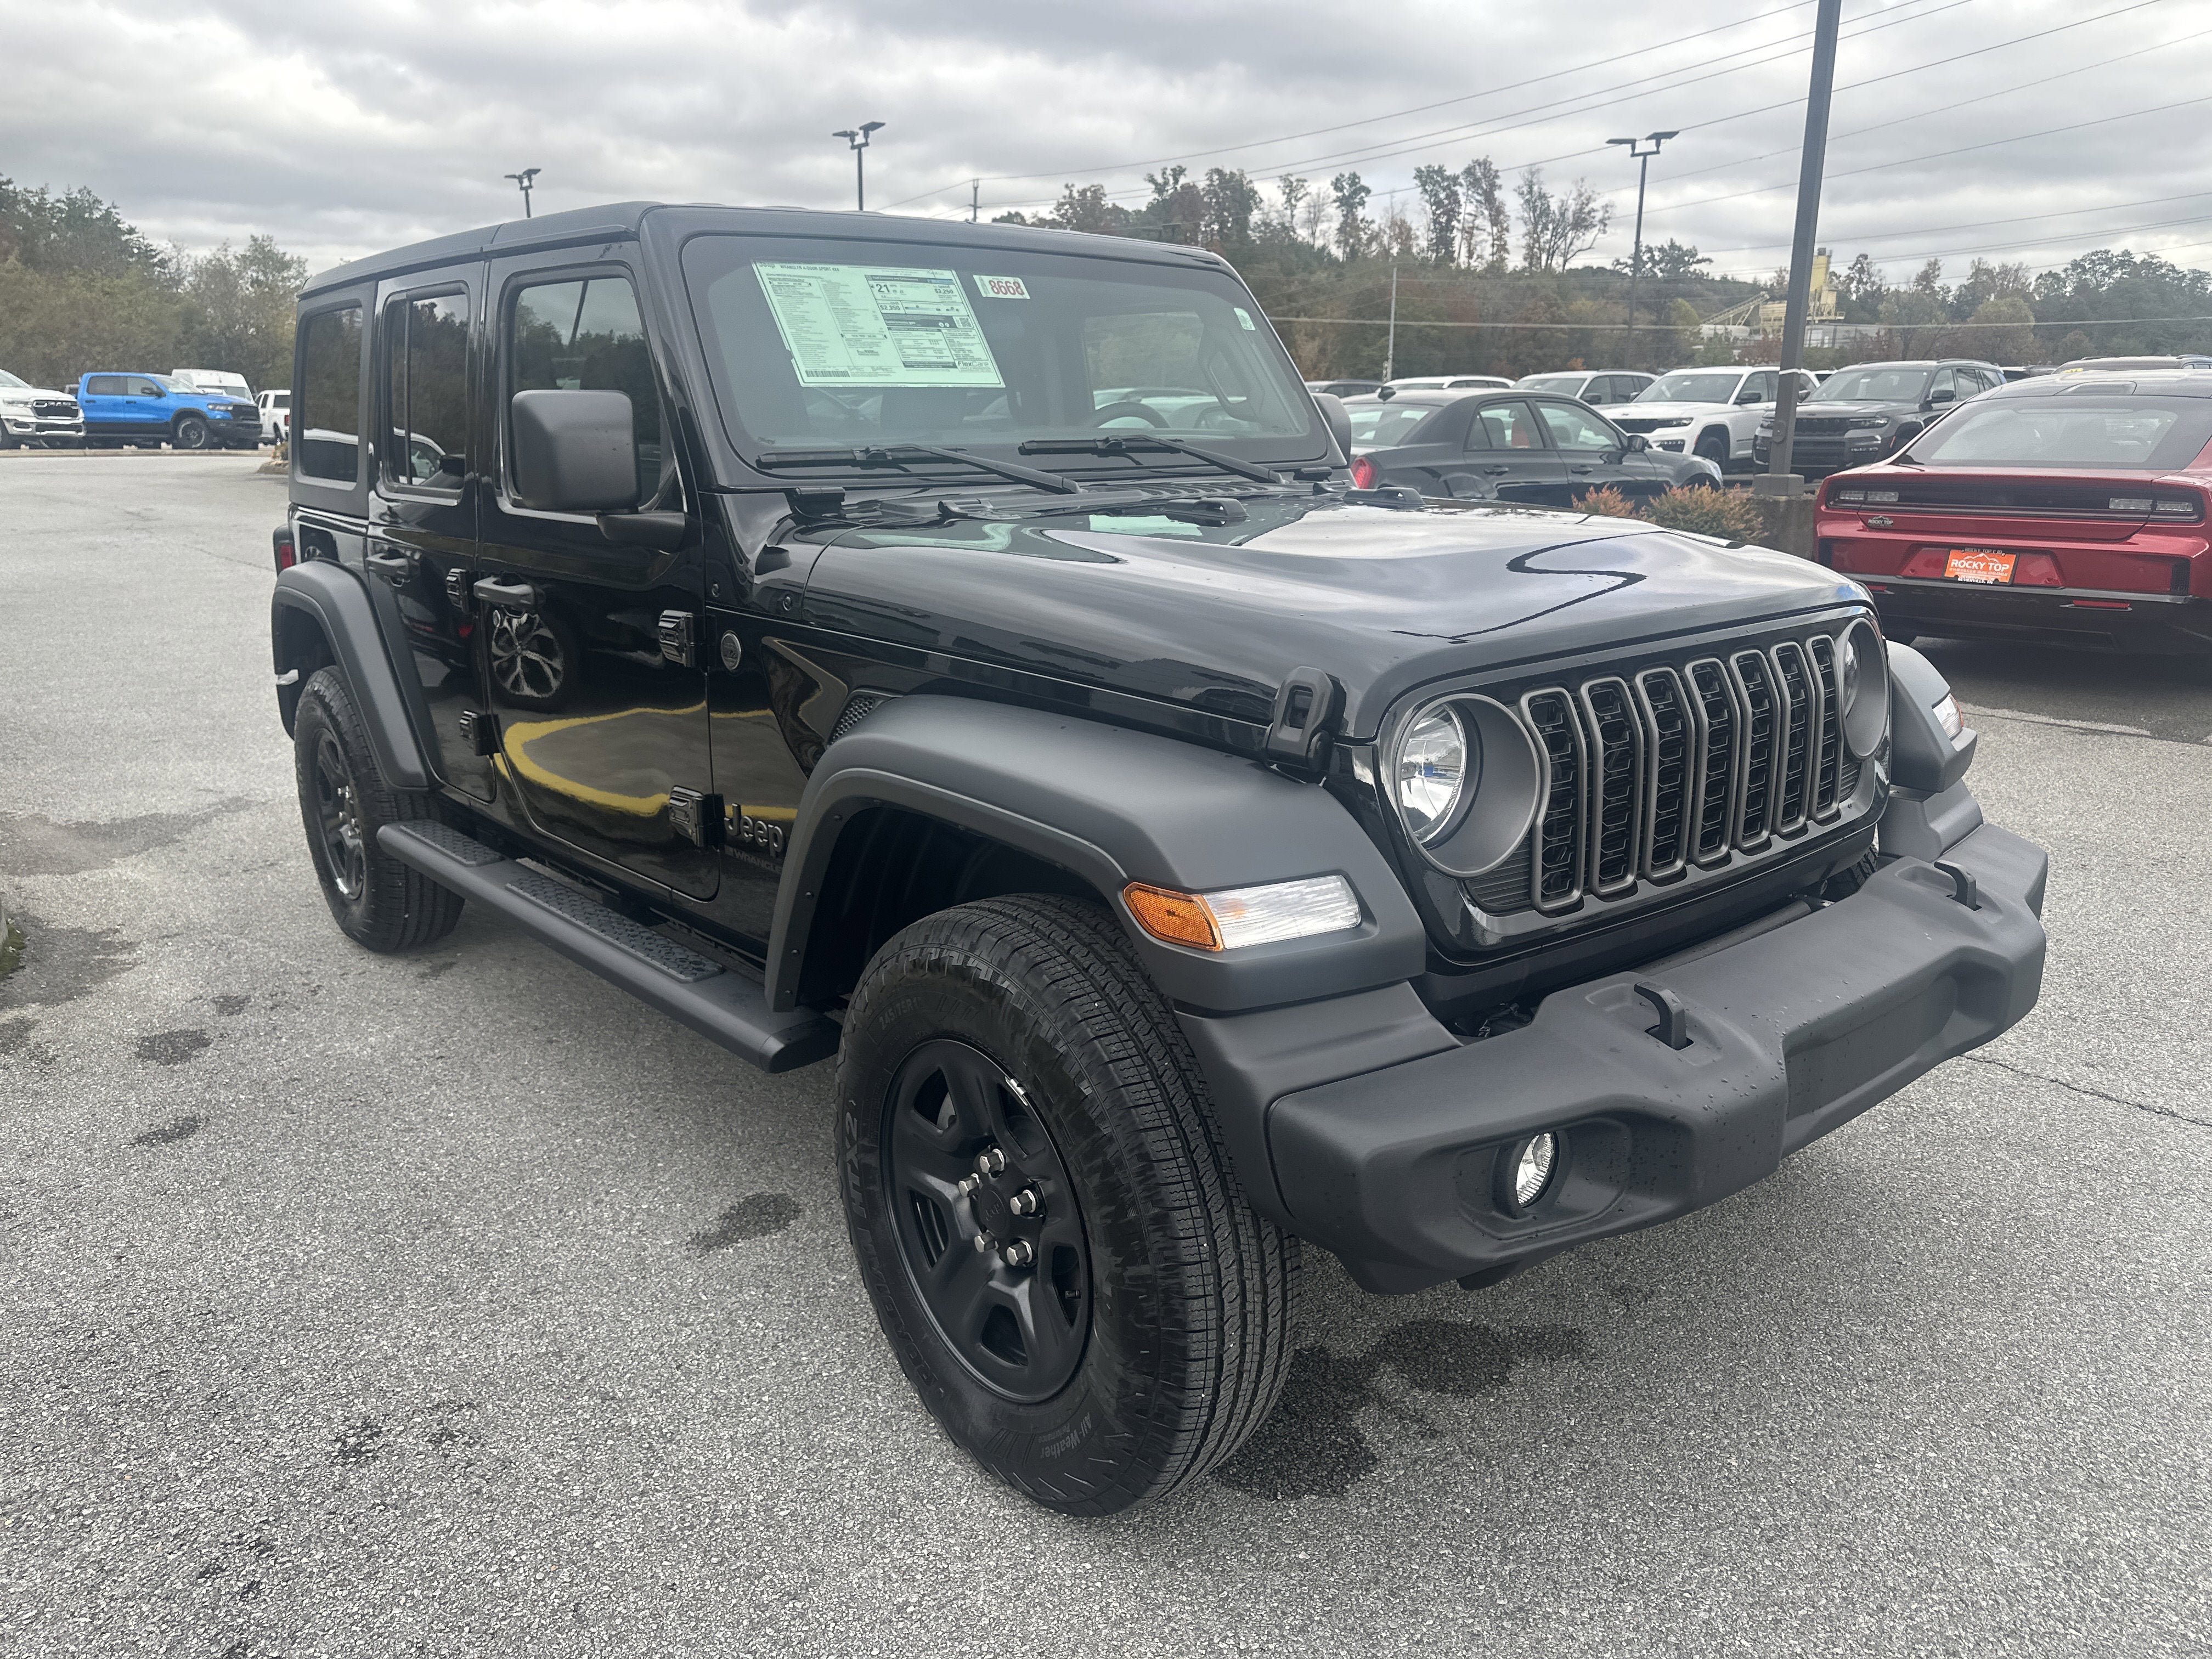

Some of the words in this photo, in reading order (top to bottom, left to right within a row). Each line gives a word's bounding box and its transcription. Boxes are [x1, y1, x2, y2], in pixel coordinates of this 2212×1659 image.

[876, 284, 890, 293] 21
[989, 280, 1025, 295] 8668
[1950, 559, 1987, 570] ROCKY
[1988, 562, 2010, 572] TOP
[724, 803, 783, 859] Jeep
[845, 1111, 867, 1218] HTX2
[1040, 1412, 1092, 1459] All-Weather
